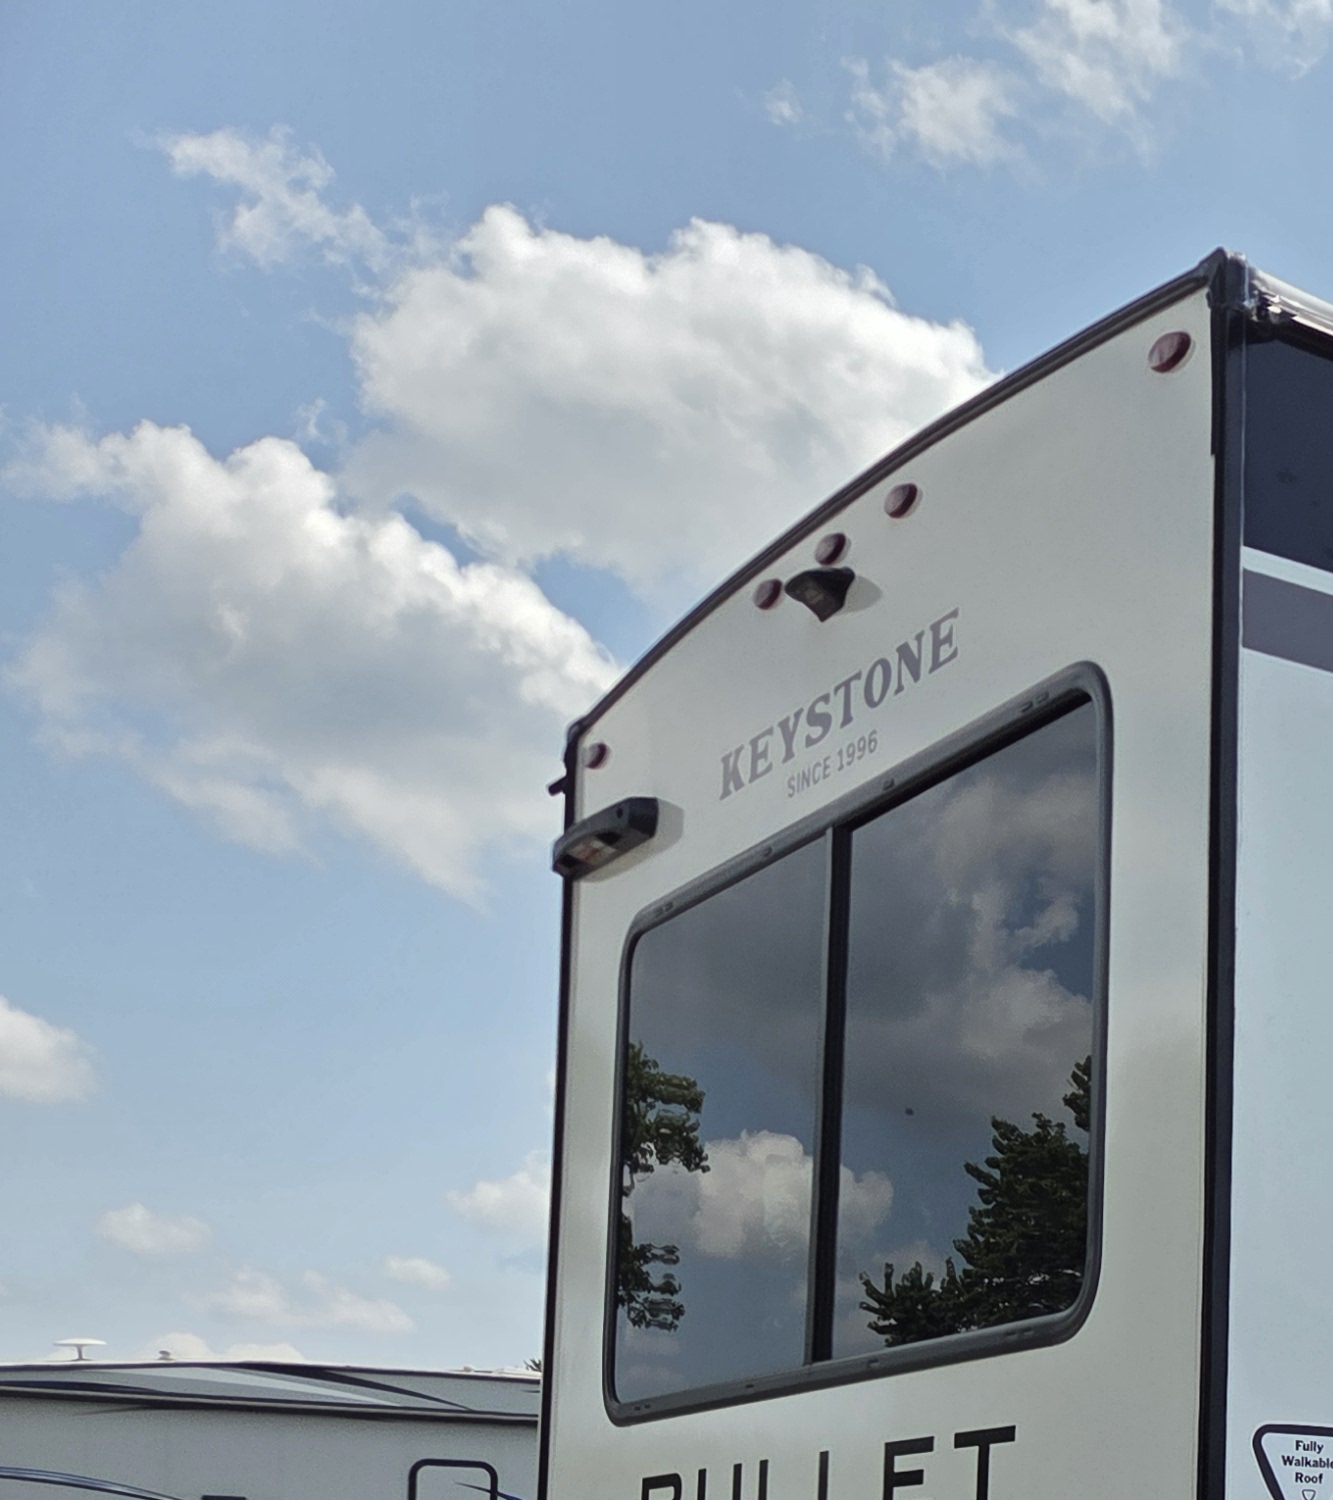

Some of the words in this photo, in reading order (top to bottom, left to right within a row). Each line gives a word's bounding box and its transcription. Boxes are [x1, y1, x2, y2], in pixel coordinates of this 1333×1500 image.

[719, 606, 960, 800] KEYSTONE
[787, 755, 831, 799] SINCE
[836, 729, 878, 772] 1996
[1295, 1440, 1324, 1454] Fully
[1294, 1472, 1324, 1484] Roof
